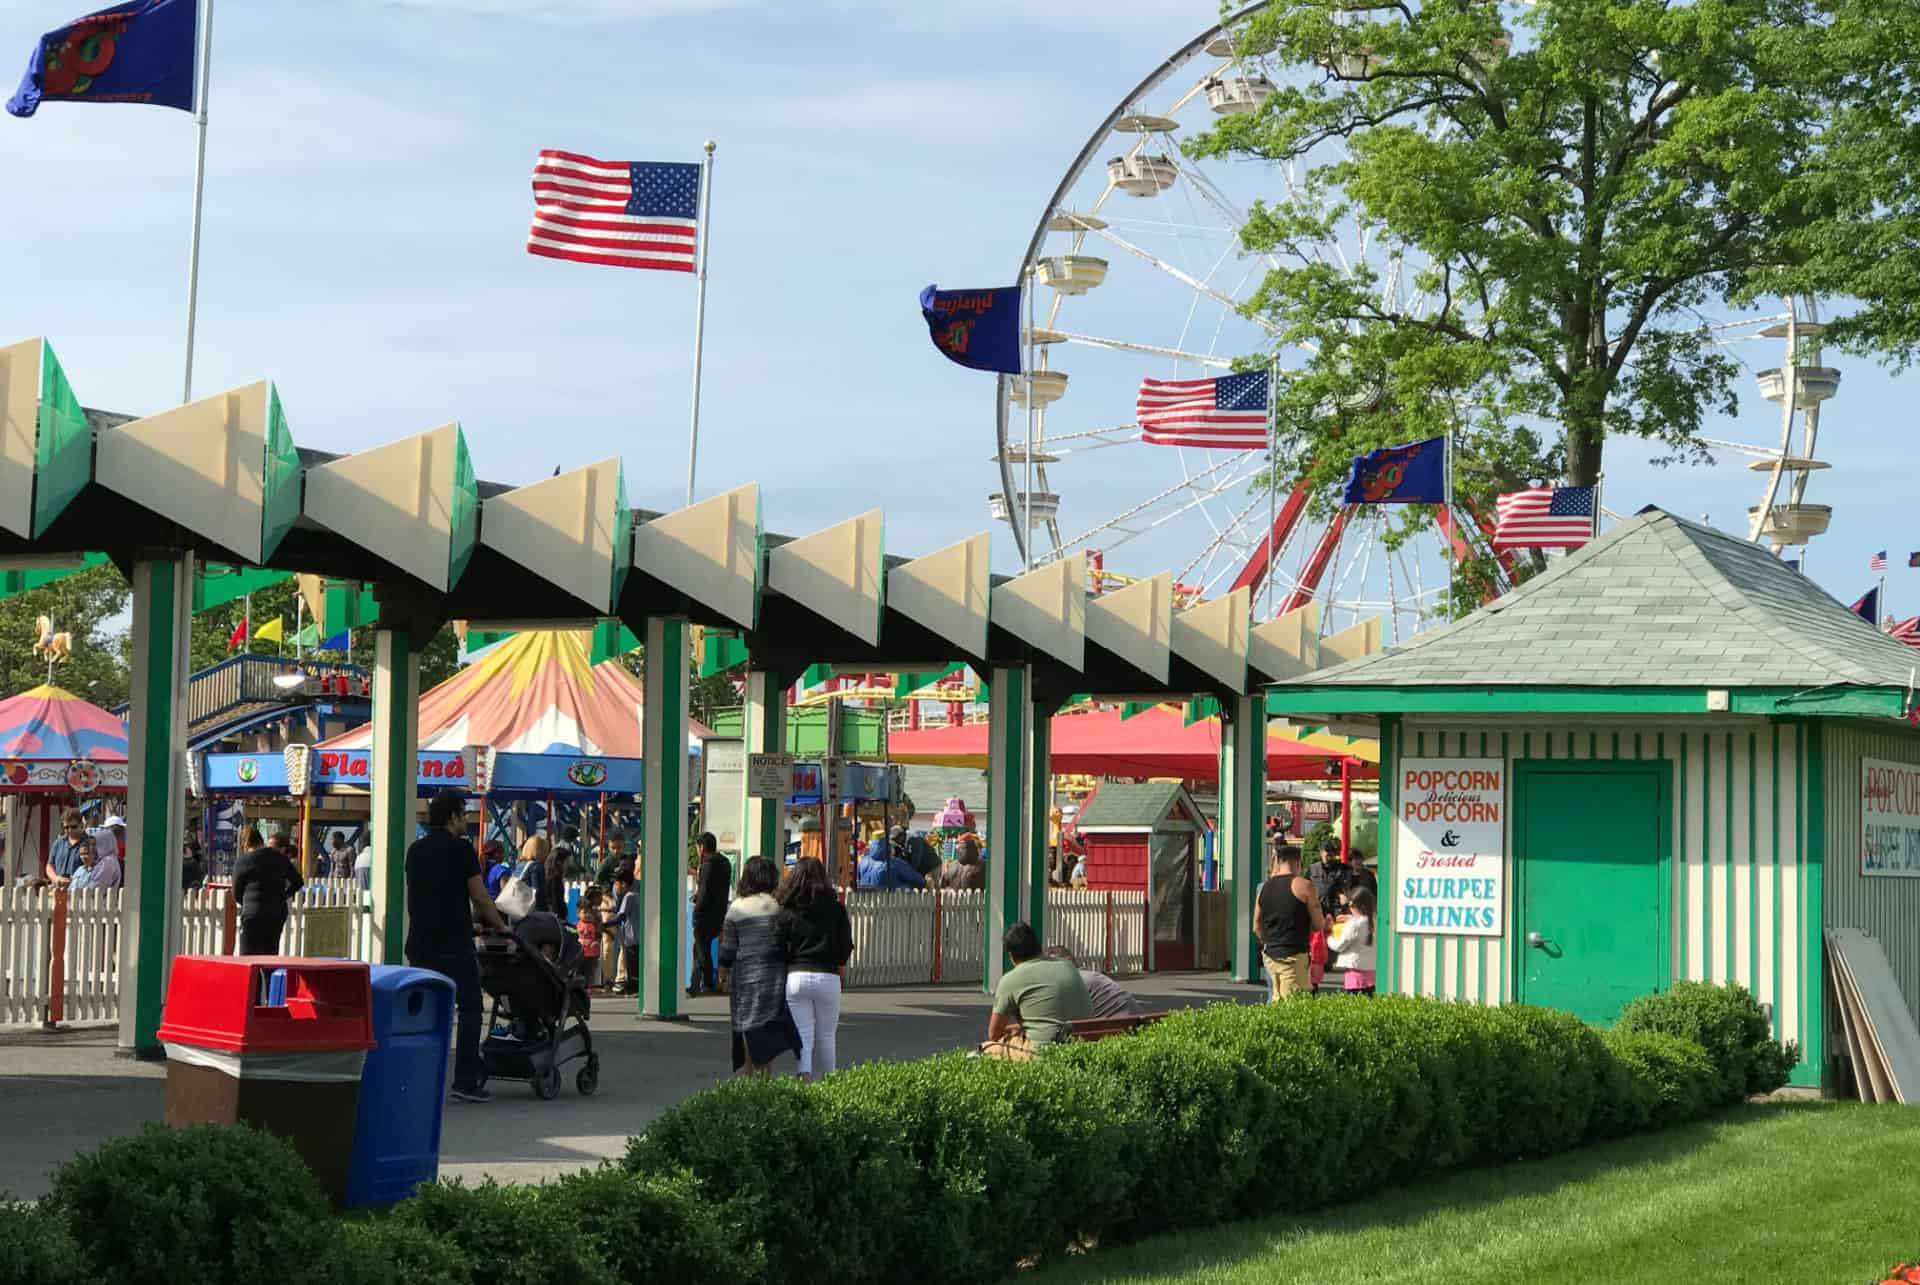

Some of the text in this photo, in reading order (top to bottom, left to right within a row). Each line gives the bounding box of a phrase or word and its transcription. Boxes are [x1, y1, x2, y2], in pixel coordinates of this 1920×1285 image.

[319, 752, 465, 779] Pland
[1405, 770, 1499, 791] POPCORN
[1426, 790, 1481, 803] Delicious
[1405, 801, 1499, 822] POPCORN
[1441, 830, 1461, 847] &
[1416, 850, 1477, 869] Frosted
[1403, 877, 1496, 899] SLURPEE
[1403, 905, 1495, 928] DRINKS
